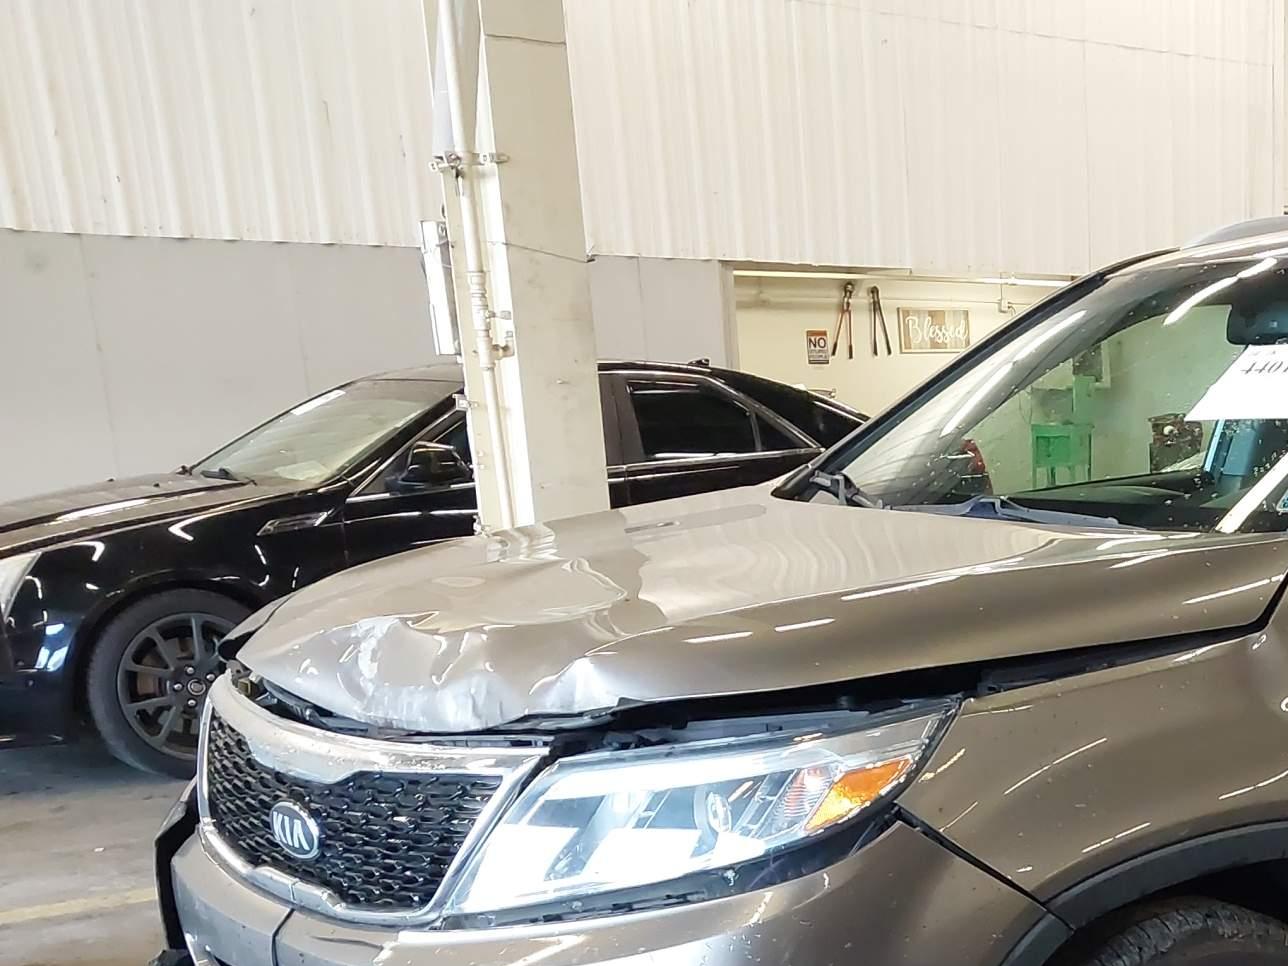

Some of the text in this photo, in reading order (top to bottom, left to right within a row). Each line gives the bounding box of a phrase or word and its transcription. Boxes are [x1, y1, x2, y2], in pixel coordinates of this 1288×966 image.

[808, 337, 827, 349] NO
[905, 316, 969, 343] Blessed
[272, 810, 311, 851] KIA
